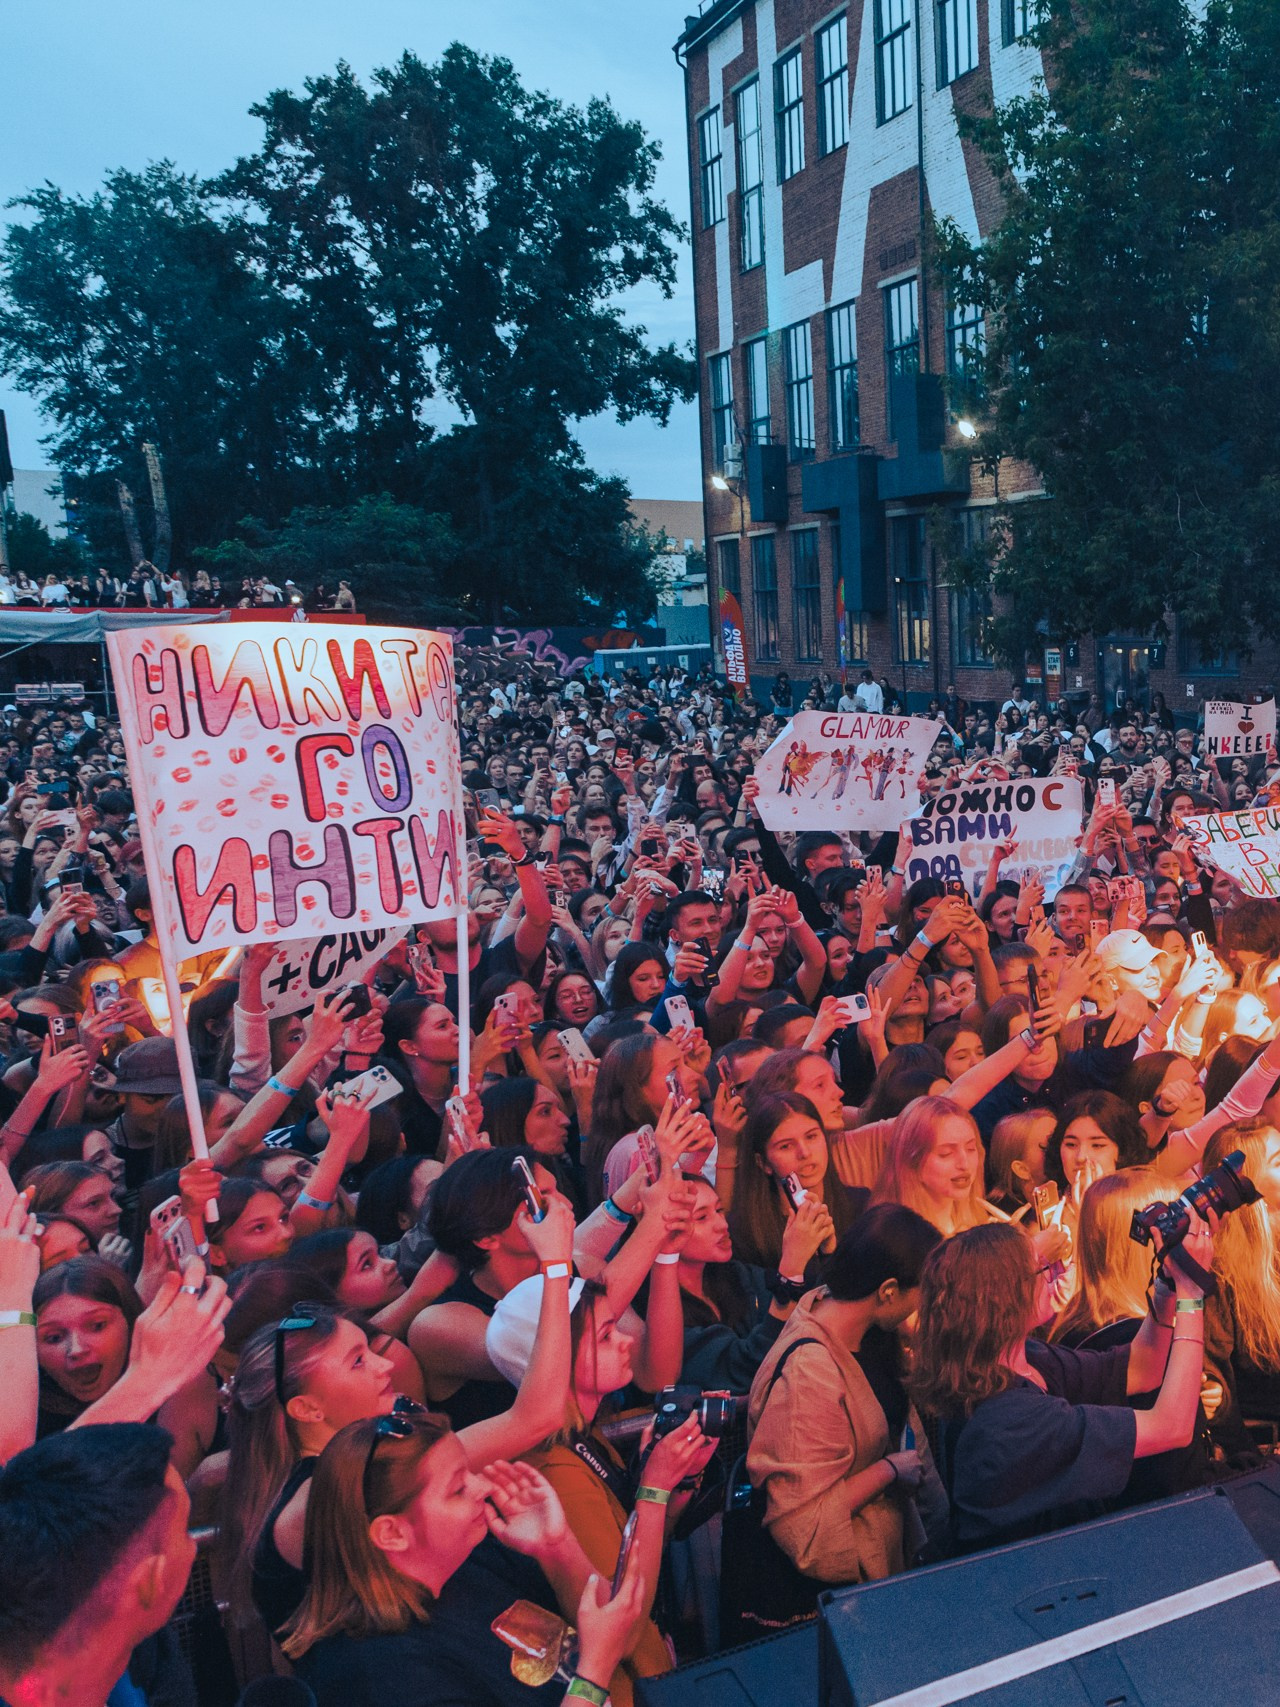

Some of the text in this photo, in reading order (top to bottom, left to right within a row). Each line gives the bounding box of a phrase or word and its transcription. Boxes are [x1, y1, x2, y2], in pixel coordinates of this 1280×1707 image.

[725, 644, 737, 682] АЛЬФА
[732, 628, 746, 683] ВЫГОДНО
[132, 637, 453, 744] НИКИТА
[820, 716, 910, 740] GLAMOUR
[295, 723, 413, 822] ГО
[1042, 782, 1064, 811] С
[911, 813, 1012, 847] ВАМИ
[1238, 842, 1269, 867] В
[172, 809, 459, 944] ИНТИ
[575, 1443, 608, 1479] Canon
